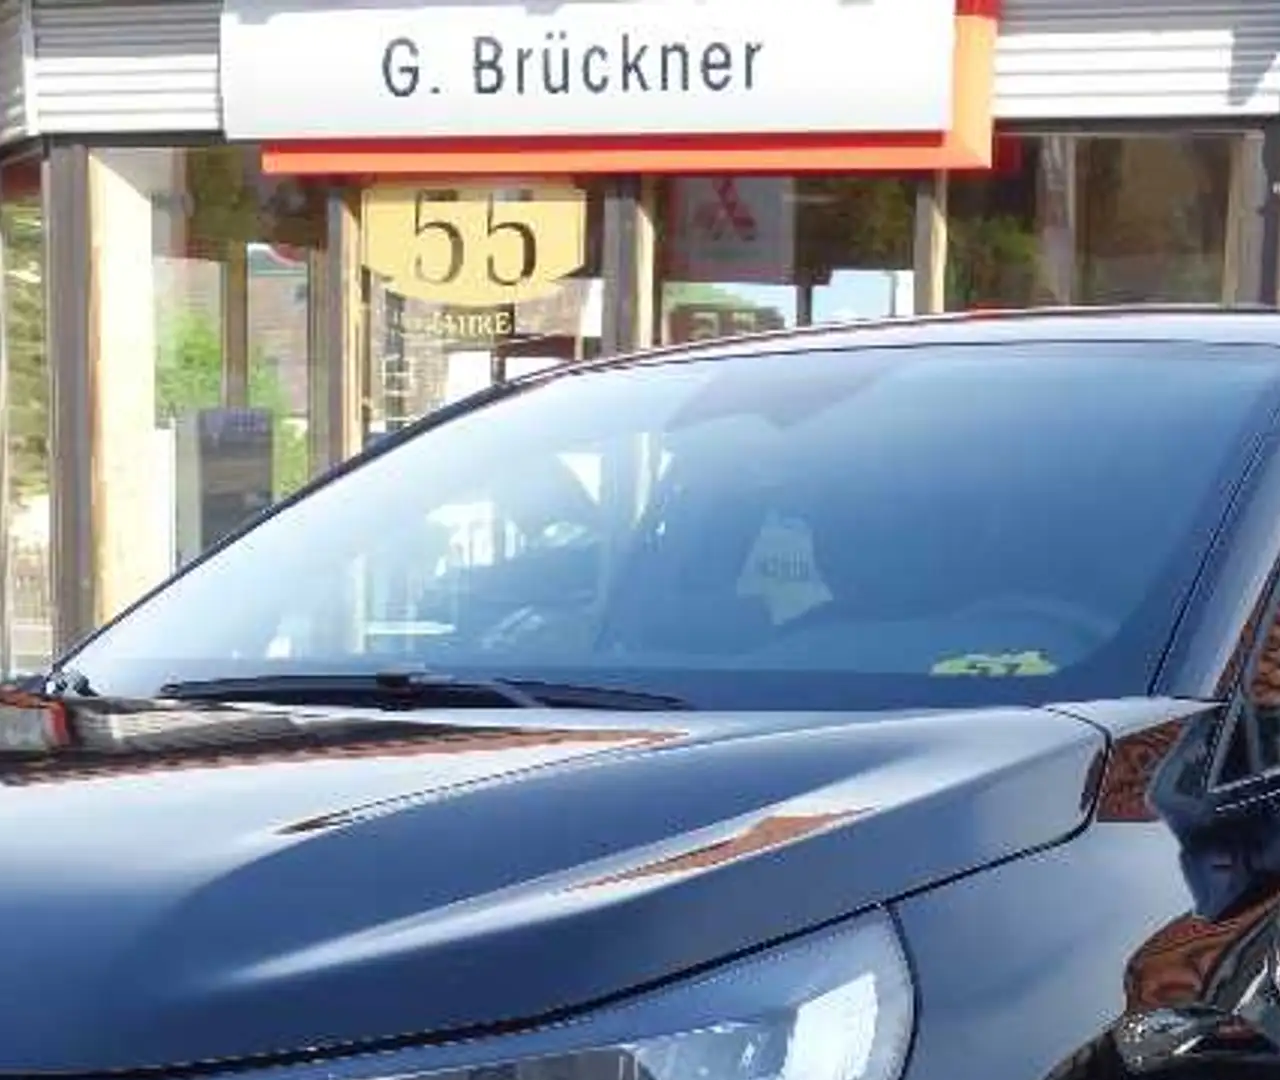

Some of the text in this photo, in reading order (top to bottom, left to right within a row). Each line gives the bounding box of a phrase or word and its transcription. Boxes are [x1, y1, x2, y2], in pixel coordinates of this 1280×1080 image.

[381, 31, 764, 98] G. Brückner
[414, 188, 537, 287] 55
